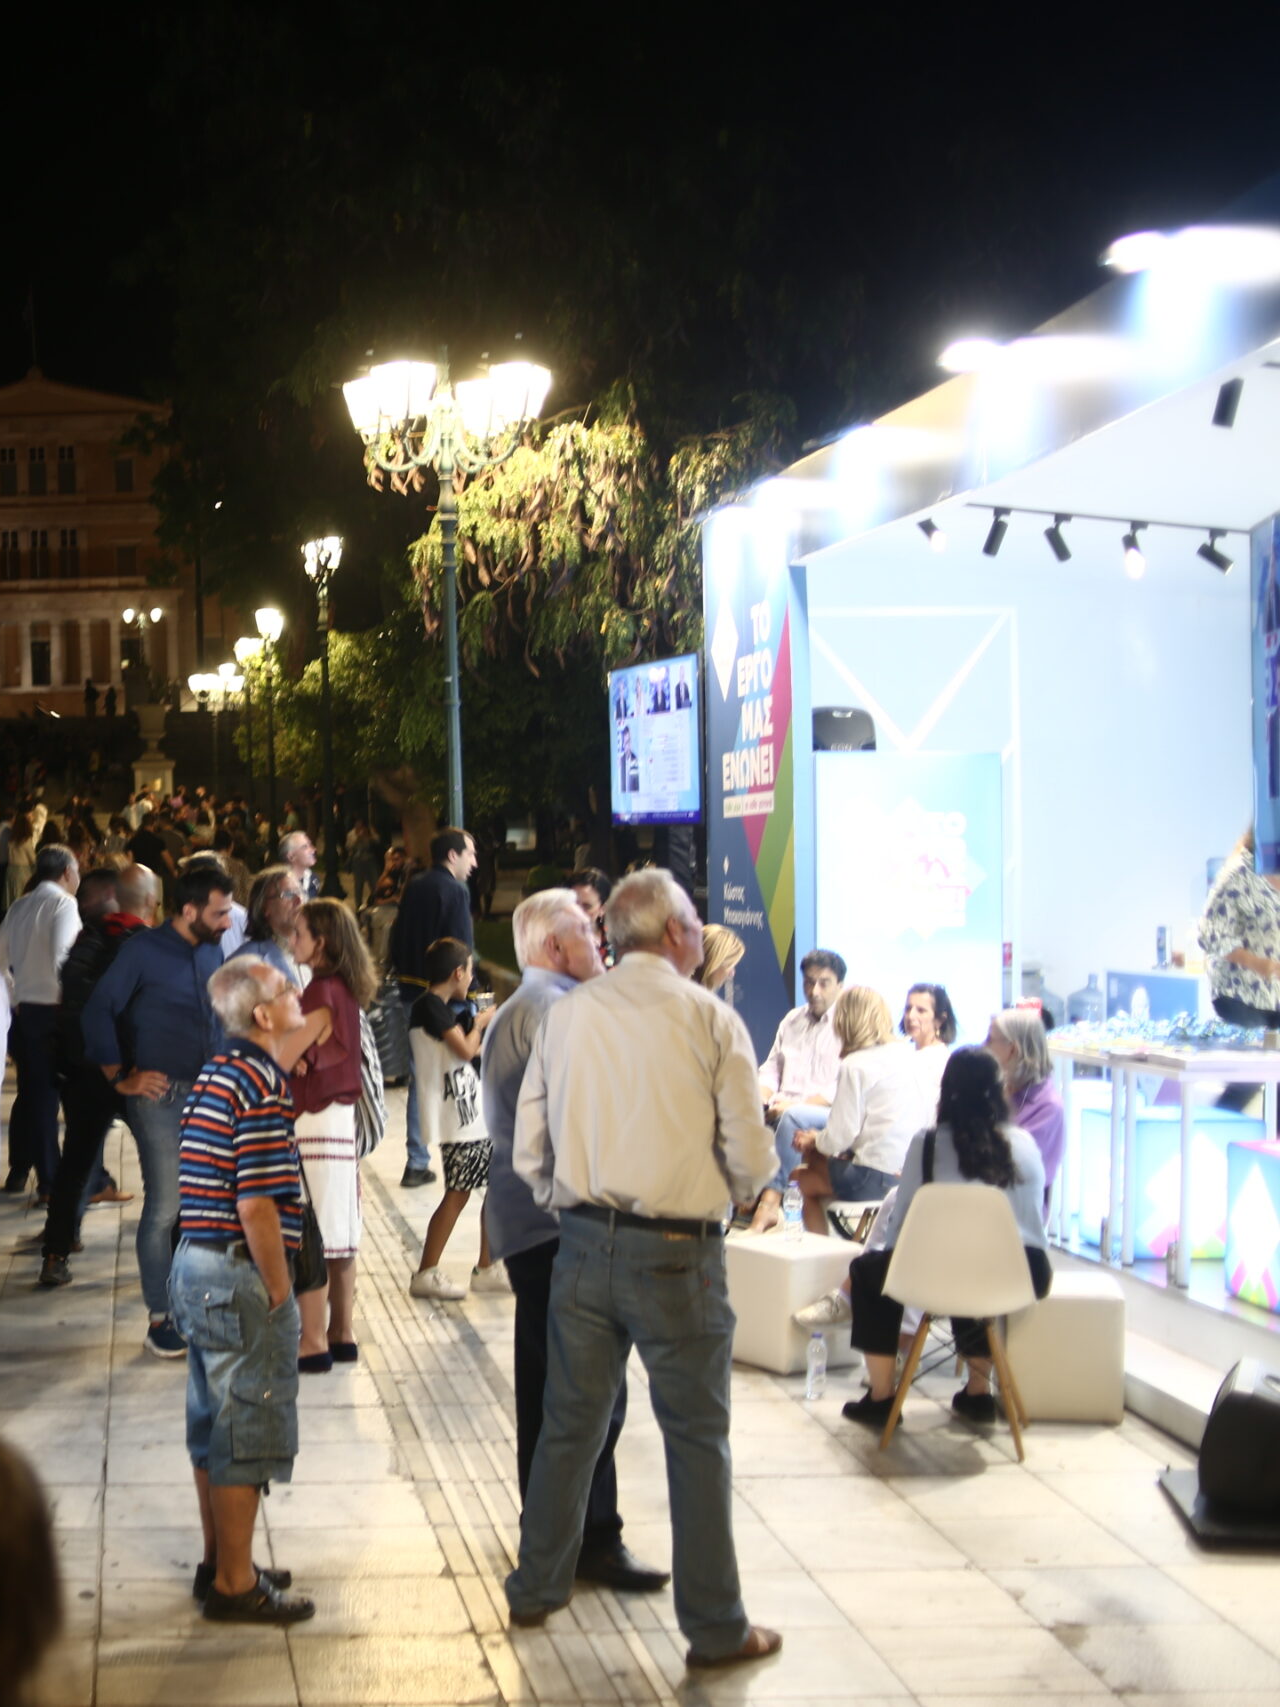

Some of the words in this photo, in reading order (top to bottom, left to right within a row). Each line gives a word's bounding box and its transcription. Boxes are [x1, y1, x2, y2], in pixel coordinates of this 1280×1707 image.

[750, 601, 771, 645] ΤΟ
[737, 648, 772, 697] ΕΡΓΟ
[741, 695, 773, 742] ΜΑΣ
[722, 742, 774, 792] ΕΝΩΝΕΙ
